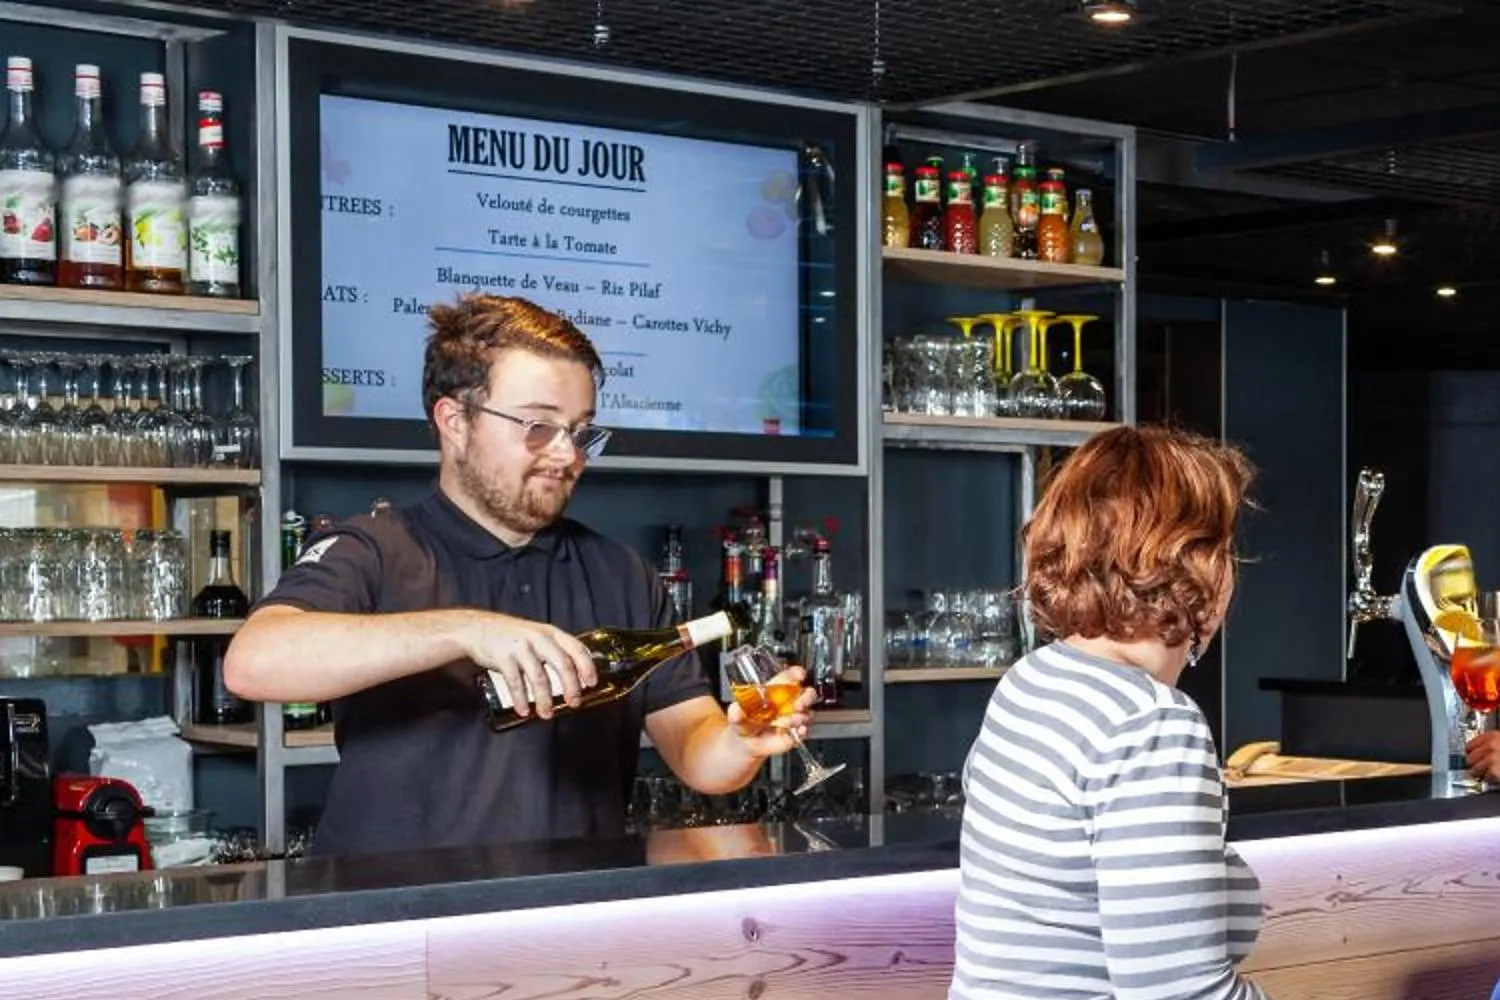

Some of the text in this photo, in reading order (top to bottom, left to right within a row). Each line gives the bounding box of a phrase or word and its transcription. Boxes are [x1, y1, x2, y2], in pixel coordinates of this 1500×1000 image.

[447, 124, 647, 183] MENU DU JOUR
[476, 191, 632, 225] Velouté de courgettes
[487, 228, 618, 255] Tarte à la Tomate
[322, 284, 358, 304] ATS
[436, 266, 516, 292] Blanquette
[520, 273, 538, 290] de
[541, 275, 580, 292] Veau
[601, 279, 624, 297] Riz
[629, 281, 663, 299] Pilaf
[631, 313, 690, 333] Carottes
[691, 317, 733, 341] Vichy
[320, 367, 385, 388] SSERTS
[602, 361, 635, 379] colat
